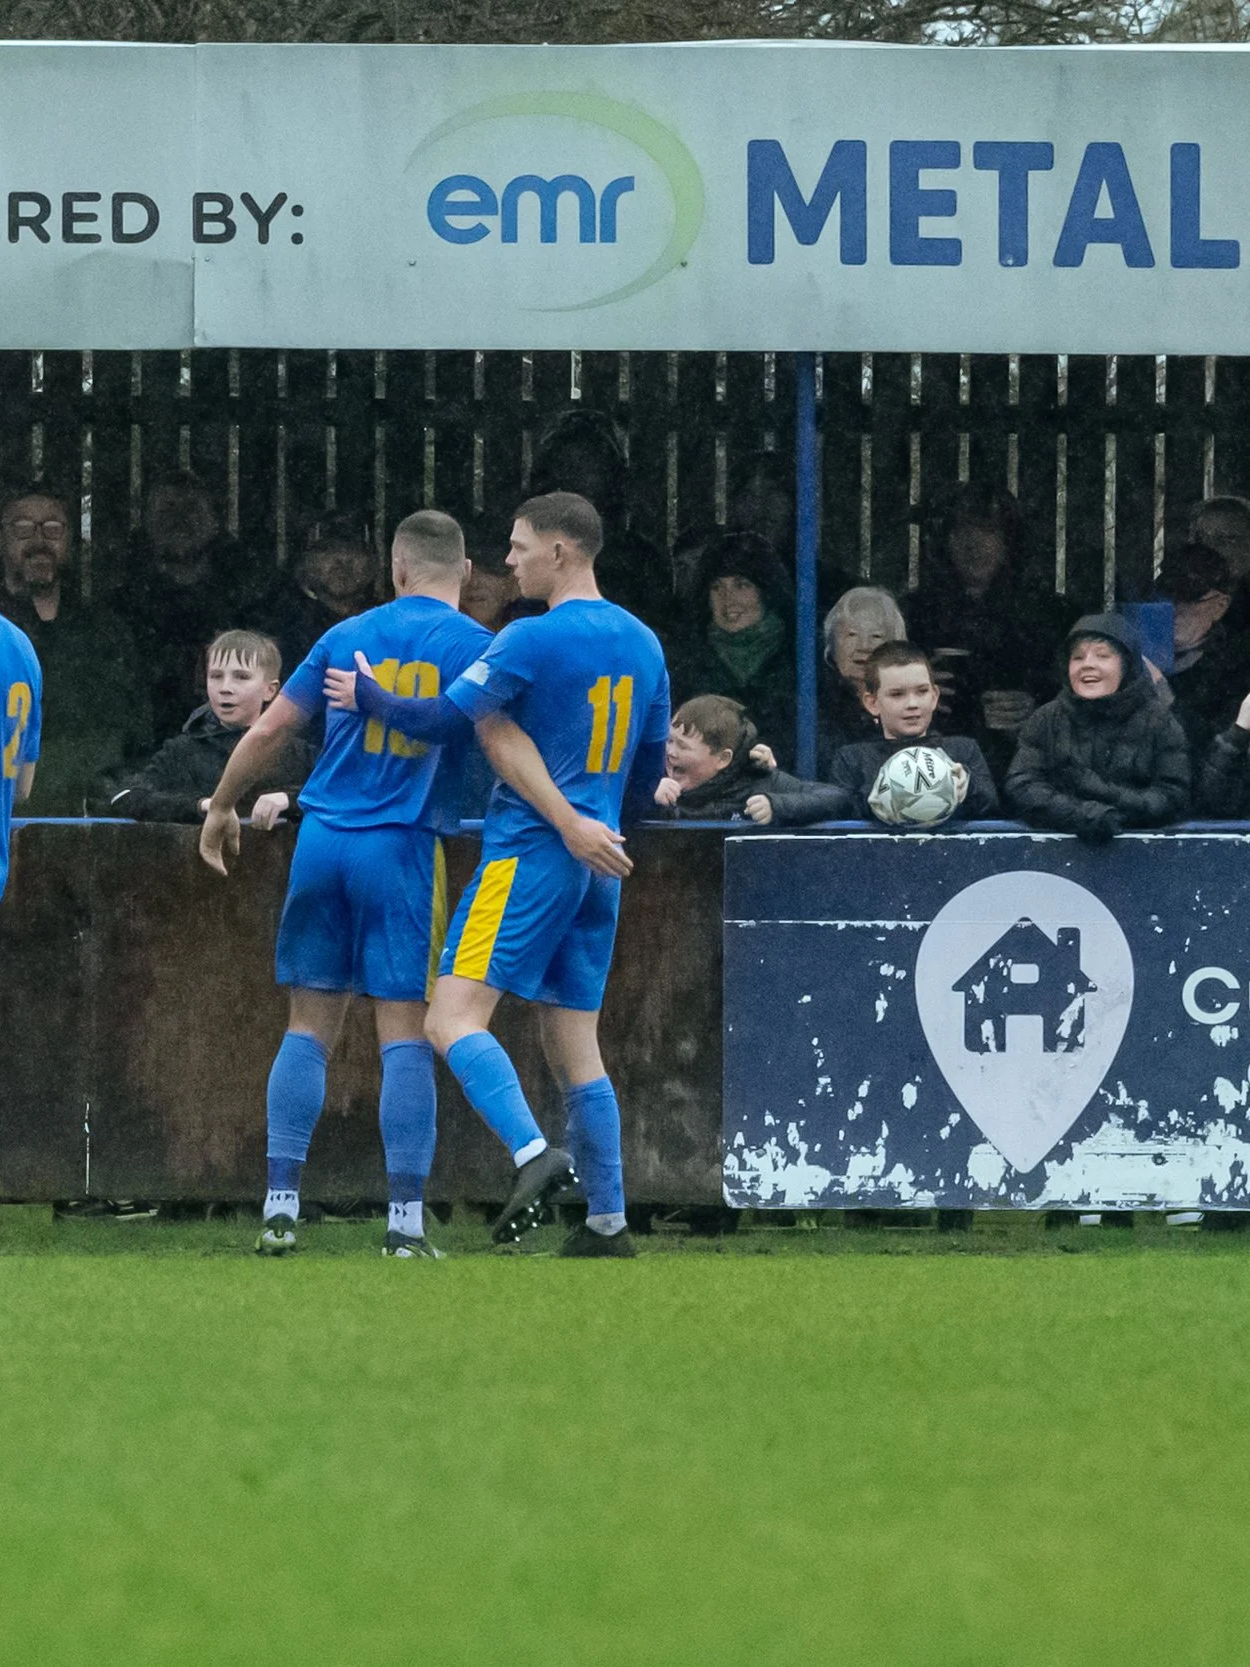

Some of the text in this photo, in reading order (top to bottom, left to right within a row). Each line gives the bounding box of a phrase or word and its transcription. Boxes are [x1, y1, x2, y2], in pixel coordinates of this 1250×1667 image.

[192, 191, 304, 244] BY:
[426, 174, 635, 245] emr
[747, 140, 1241, 268] METAL
[2, 681, 32, 780] 2
[586, 675, 634, 773] 11
[1181, 965, 1250, 1026] C
